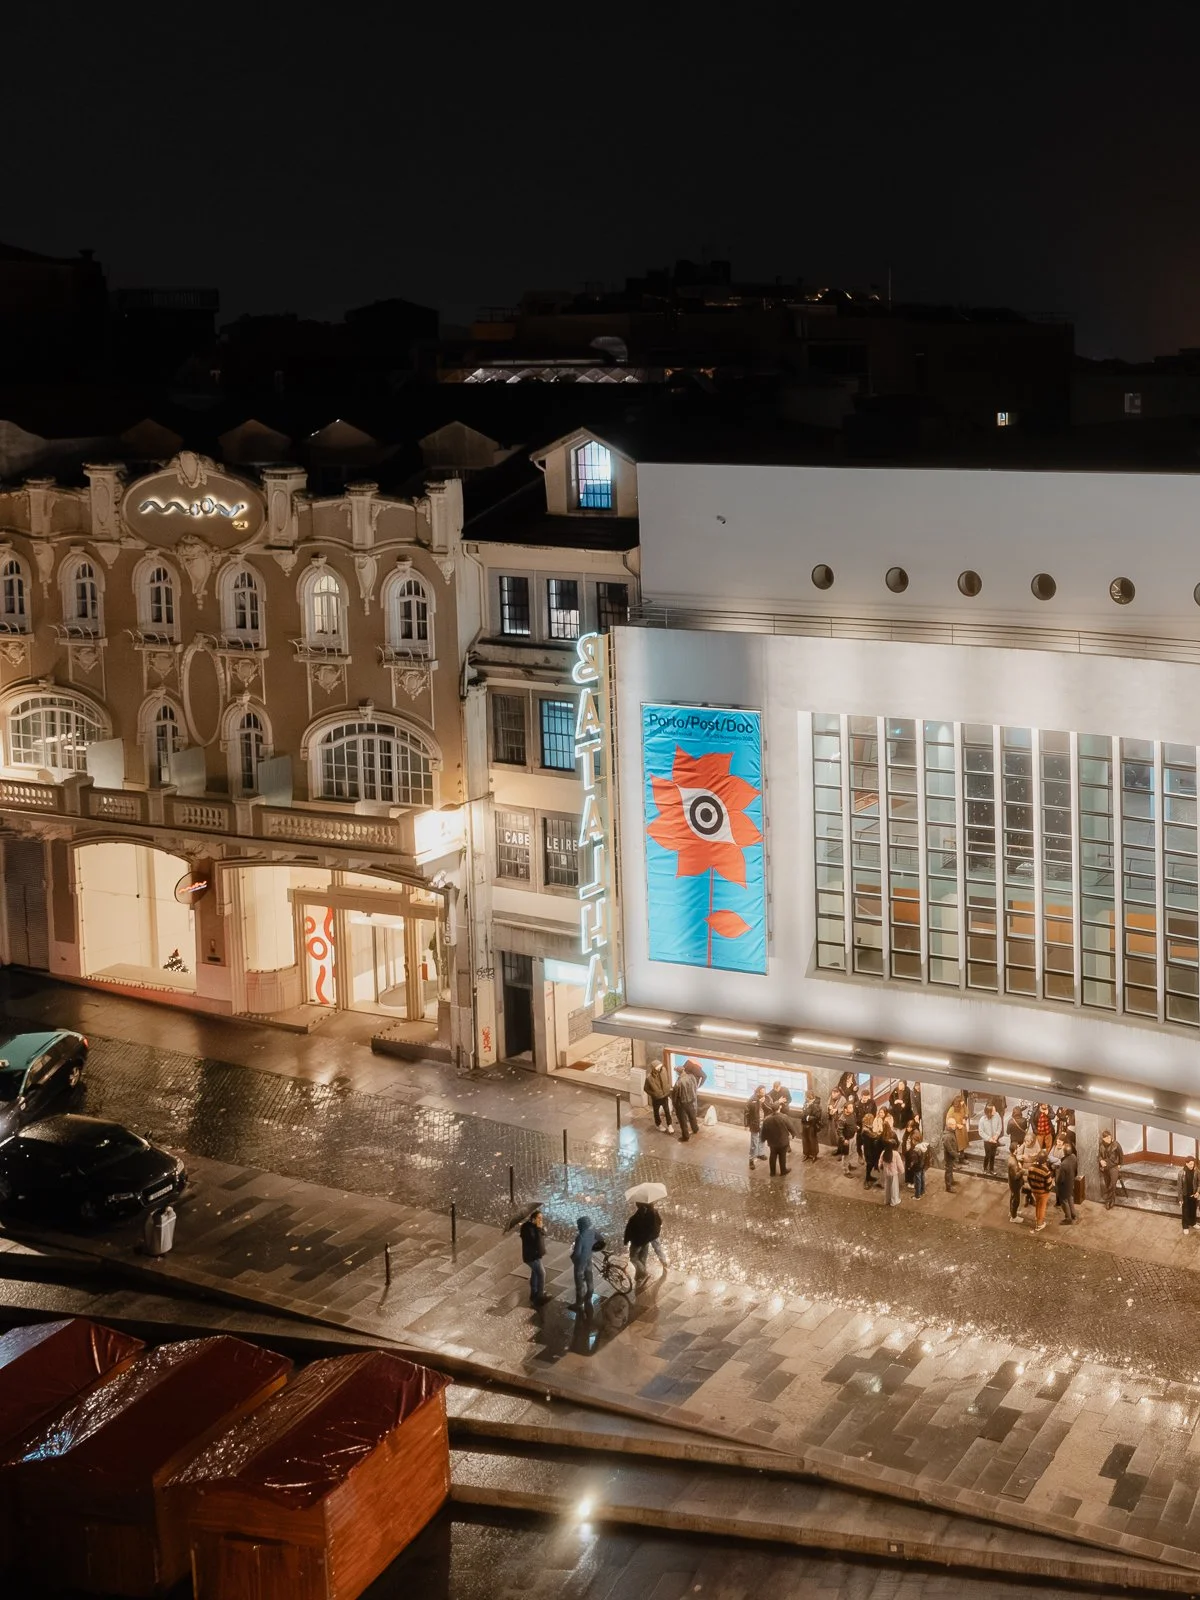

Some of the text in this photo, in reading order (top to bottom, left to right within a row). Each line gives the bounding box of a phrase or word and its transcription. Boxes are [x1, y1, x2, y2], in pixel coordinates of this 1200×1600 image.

[649, 713, 755, 734] Porto/Post/Doc
[505, 831, 578, 851] CABE LEIRE
